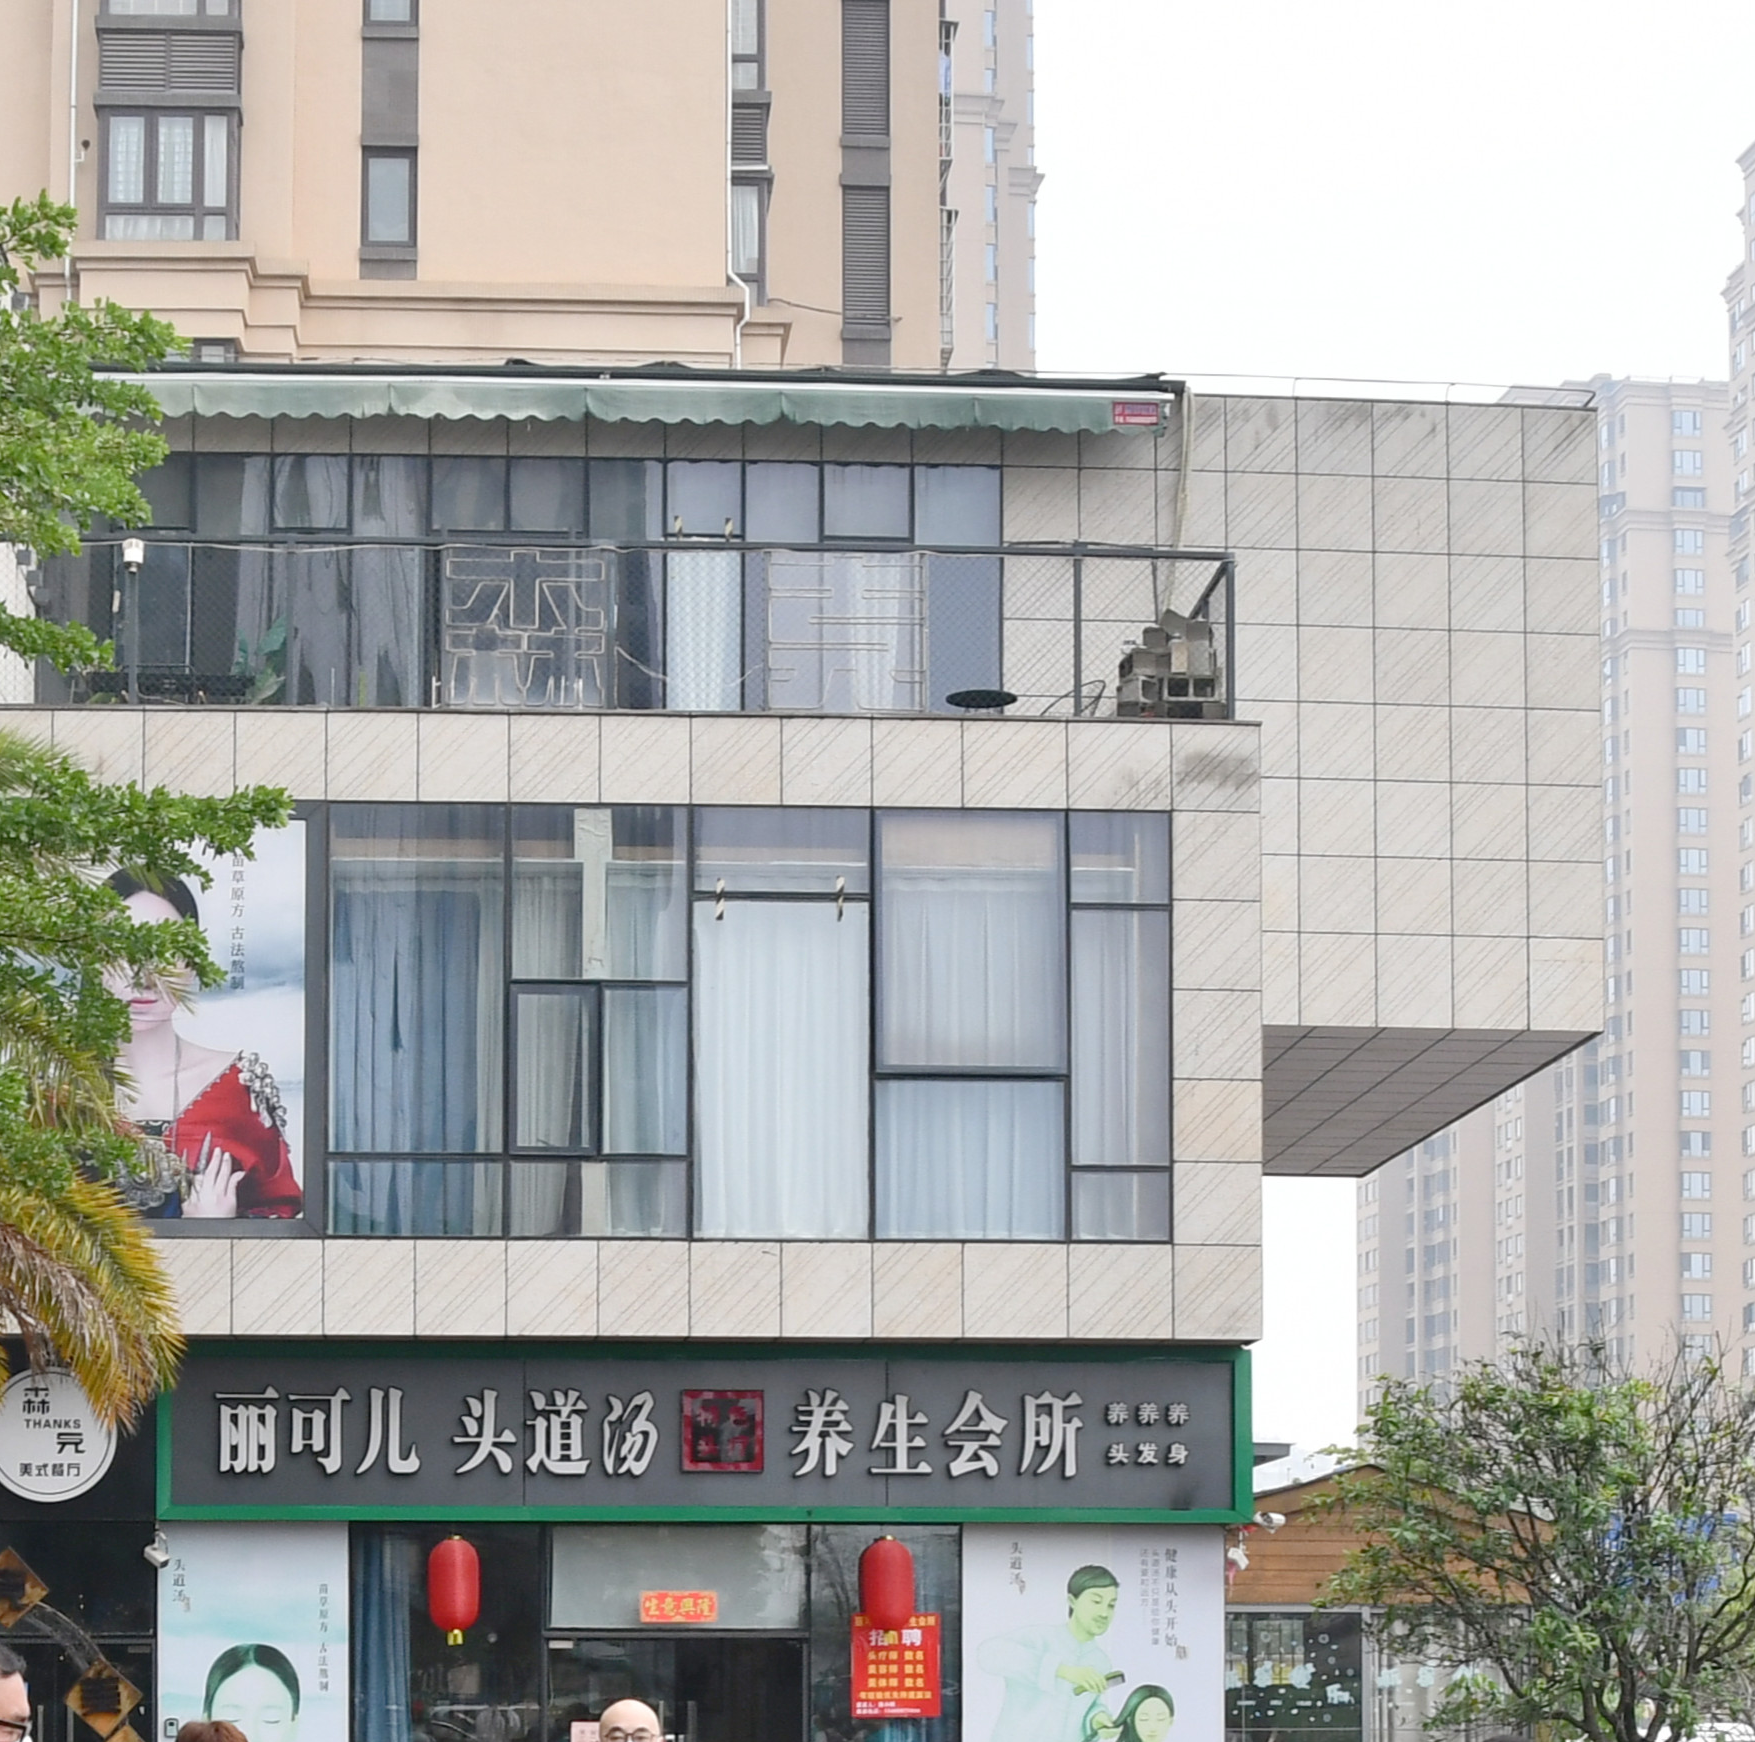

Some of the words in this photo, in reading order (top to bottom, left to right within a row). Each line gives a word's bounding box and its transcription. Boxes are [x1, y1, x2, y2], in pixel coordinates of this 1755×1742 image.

[23, 1387, 50, 1414] 森
[24, 1418, 81, 1429] THANKS
[1107, 1402, 1189, 1424] 养养养
[215, 1386, 421, 1478] 丽可儿
[453, 1386, 657, 1478] 头道汤
[789, 1388, 1085, 1478] 养生会所
[1107, 1443, 1189, 1464] 头发身
[19, 1463, 81, 1477] 美式餐厅
[1010, 1542, 1024, 1586] 头道汤
[172, 1558, 187, 1603] 头道汤
[1165, 1548, 1179, 1648] 健康从头开始
[869, 1628, 923, 1647] 招聘
